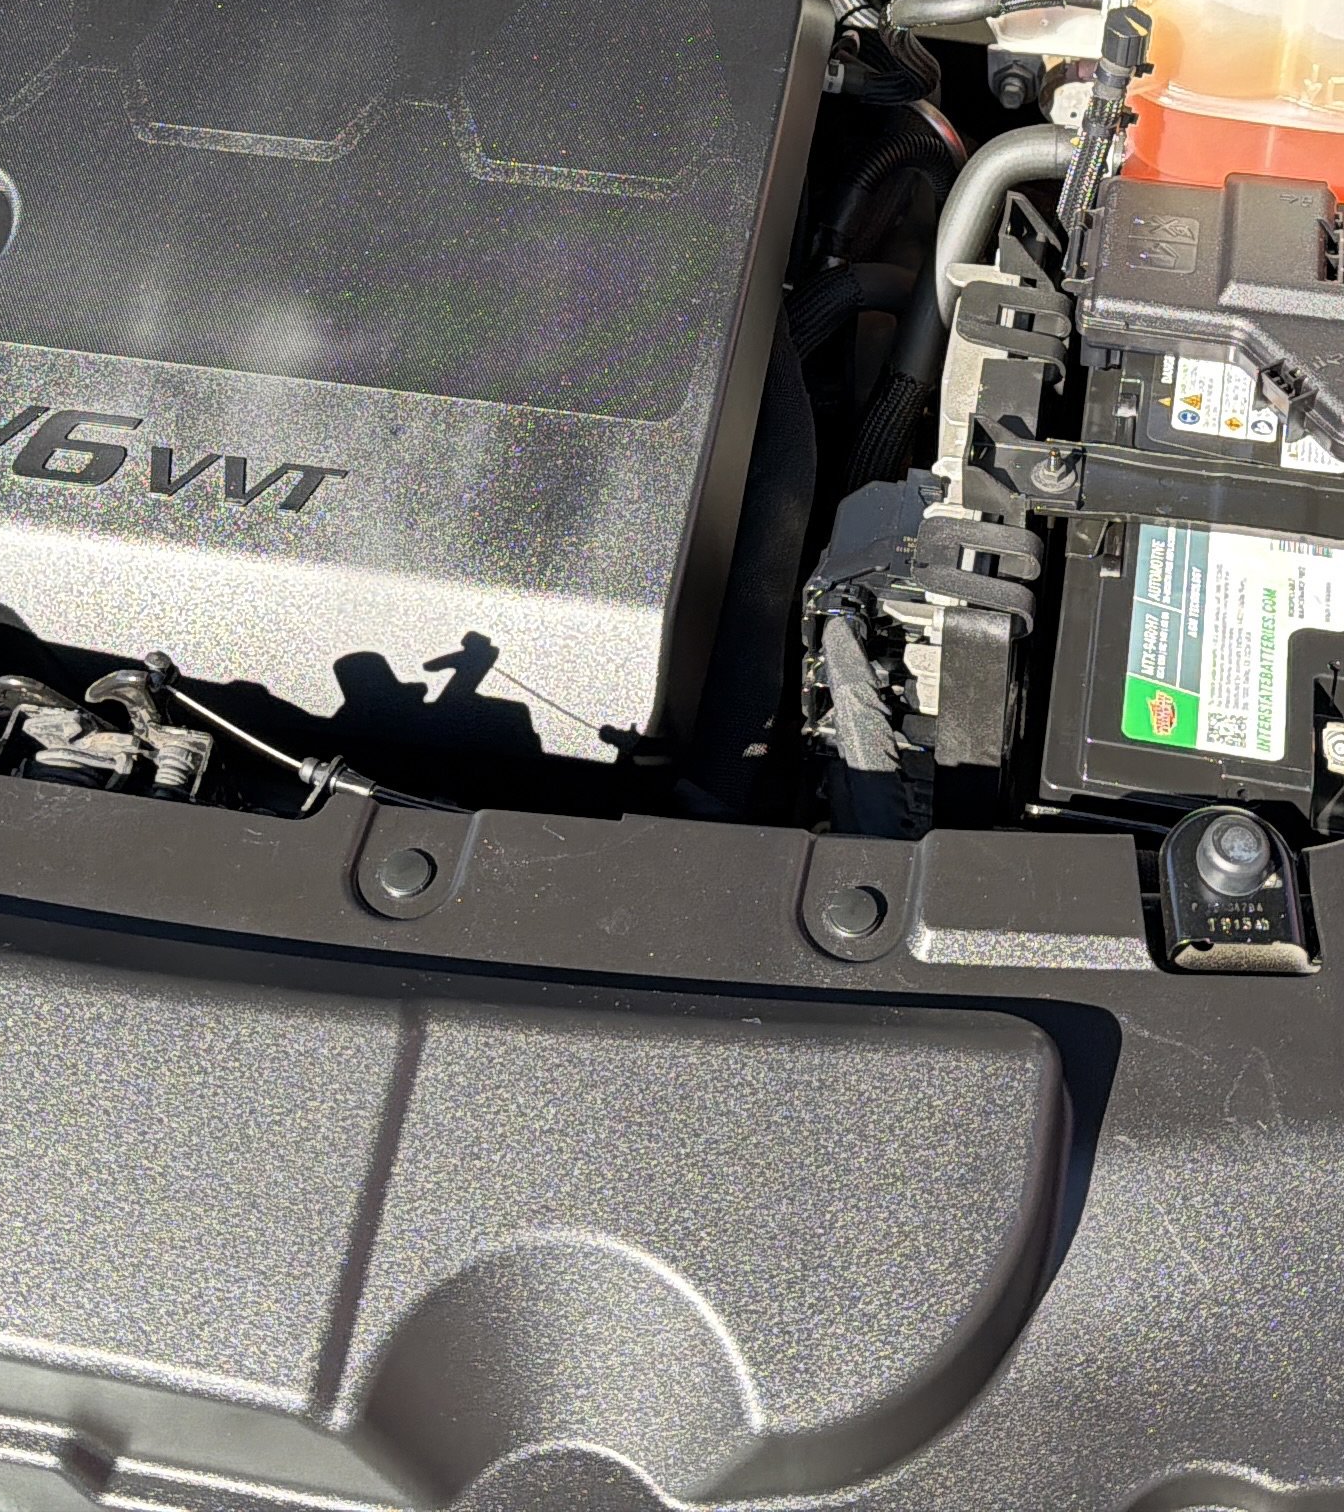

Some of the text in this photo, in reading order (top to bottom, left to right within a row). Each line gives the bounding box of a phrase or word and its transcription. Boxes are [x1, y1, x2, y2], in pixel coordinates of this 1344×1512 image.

[146, 445, 349, 513] VVT
[1148, 538, 1166, 602] AUTOMOTIVE
[1256, 587, 1278, 753] INTERSTATEBATTERIES.COM
